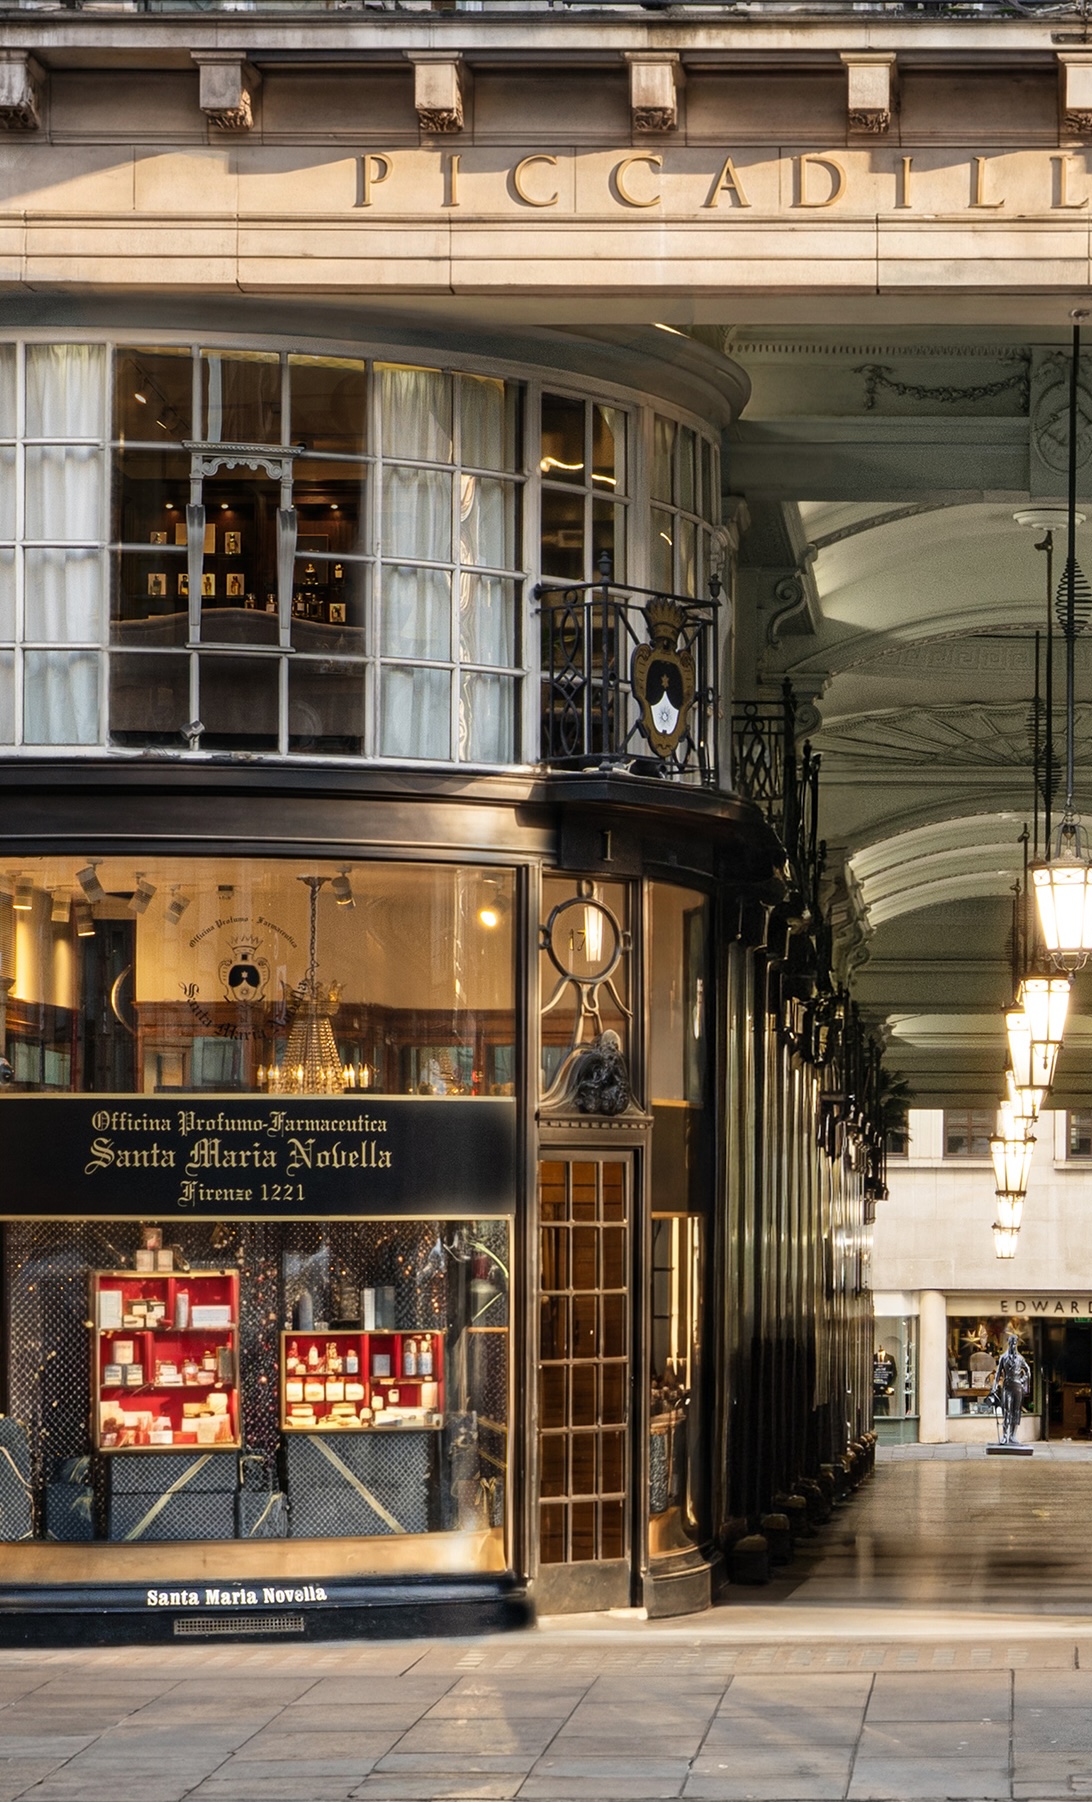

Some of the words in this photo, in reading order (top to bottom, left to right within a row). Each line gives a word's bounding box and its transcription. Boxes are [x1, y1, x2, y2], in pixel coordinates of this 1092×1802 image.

[188, 925, 216, 949] Officina
[214, 915, 249, 929] Profumo
[91, 1110, 172, 1132] Officina
[177, 1110, 388, 1137] Profumo-Farmaceutica
[84, 1137, 176, 1175] Santa
[184, 1137, 278, 1177] Maria
[286, 1137, 393, 1177] Novella
[177, 1180, 254, 1207] Firenze
[261, 1184, 306, 1201] 1221
[147, 1589, 200, 1606] Santa
[205, 1588, 258, 1605] Maria
[263, 1586, 328, 1604] Novella
